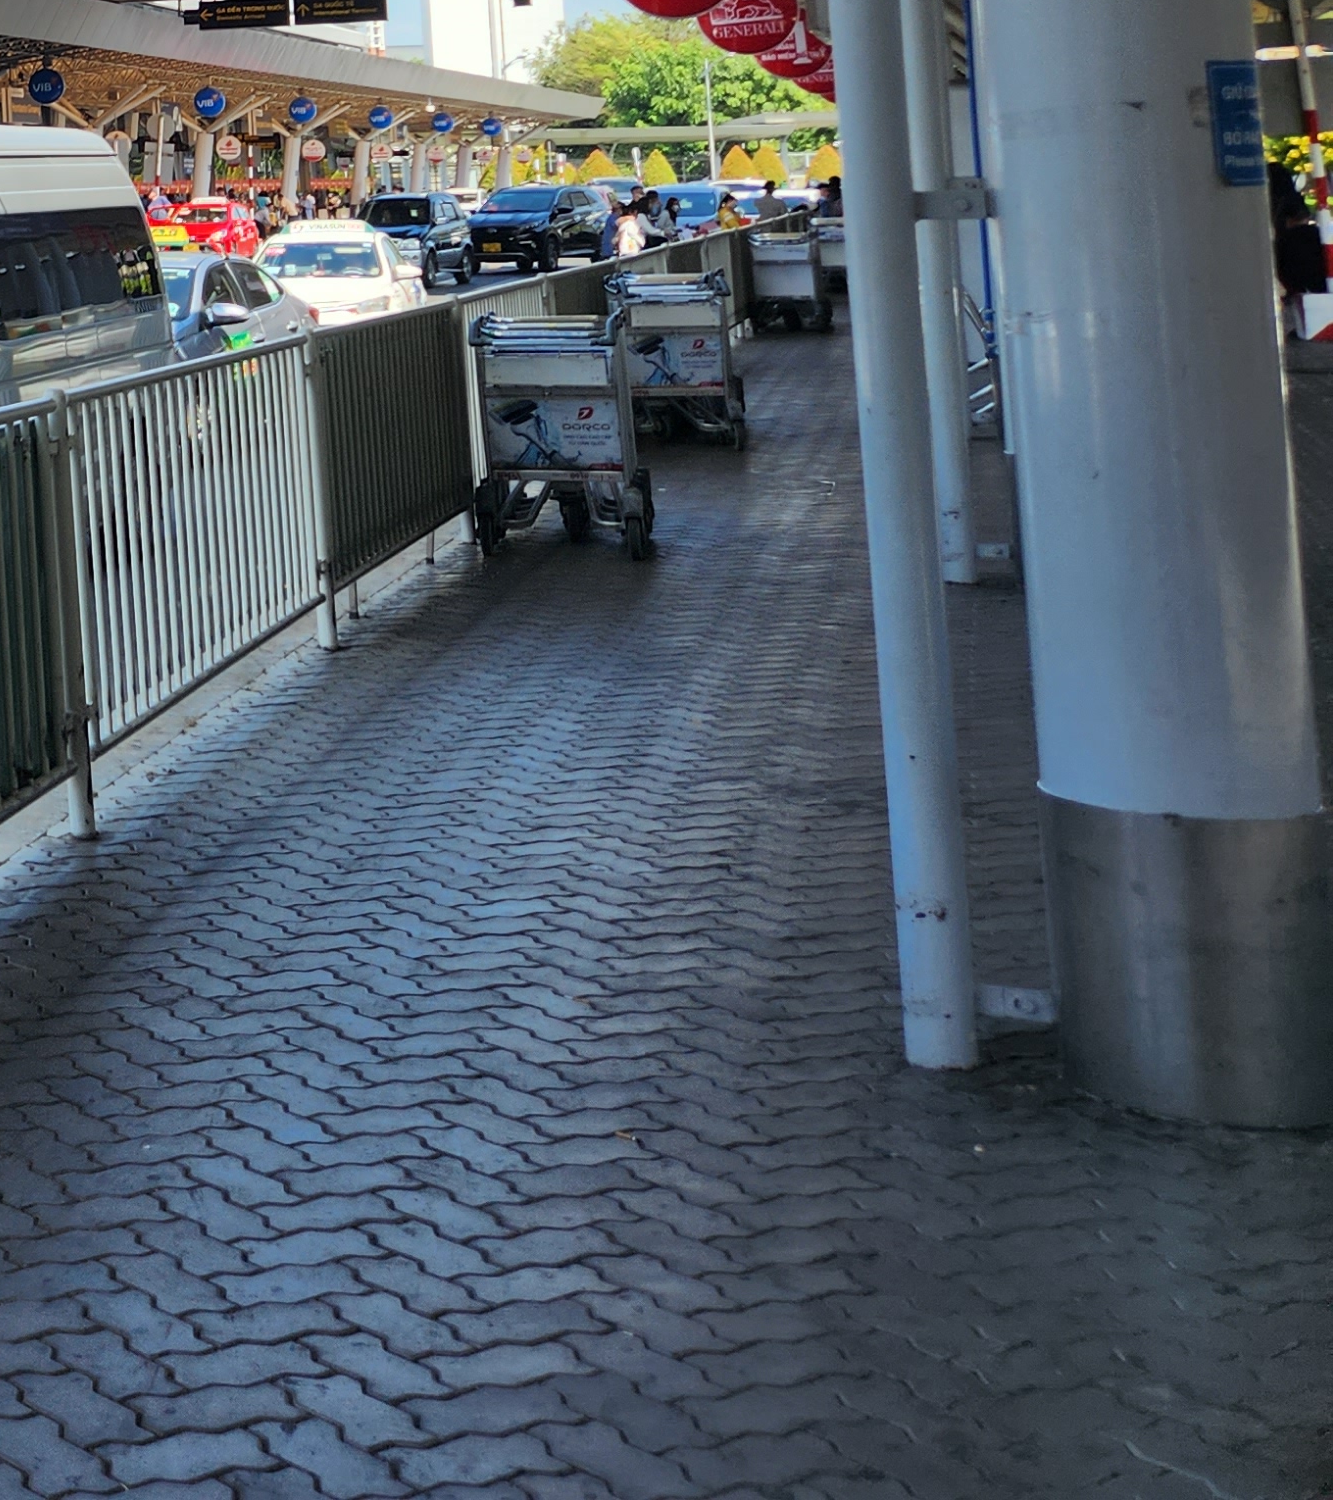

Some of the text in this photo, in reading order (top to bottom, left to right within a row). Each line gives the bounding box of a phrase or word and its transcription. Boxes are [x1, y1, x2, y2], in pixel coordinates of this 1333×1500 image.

[713, 20, 785, 40] GENERALI
[32, 82, 52, 93] VIB
[196, 98, 214, 108] VIB
[291, 106, 306, 115] VIB
[370, 115, 386, 123] VIB
[562, 423, 611, 432] DORCO
